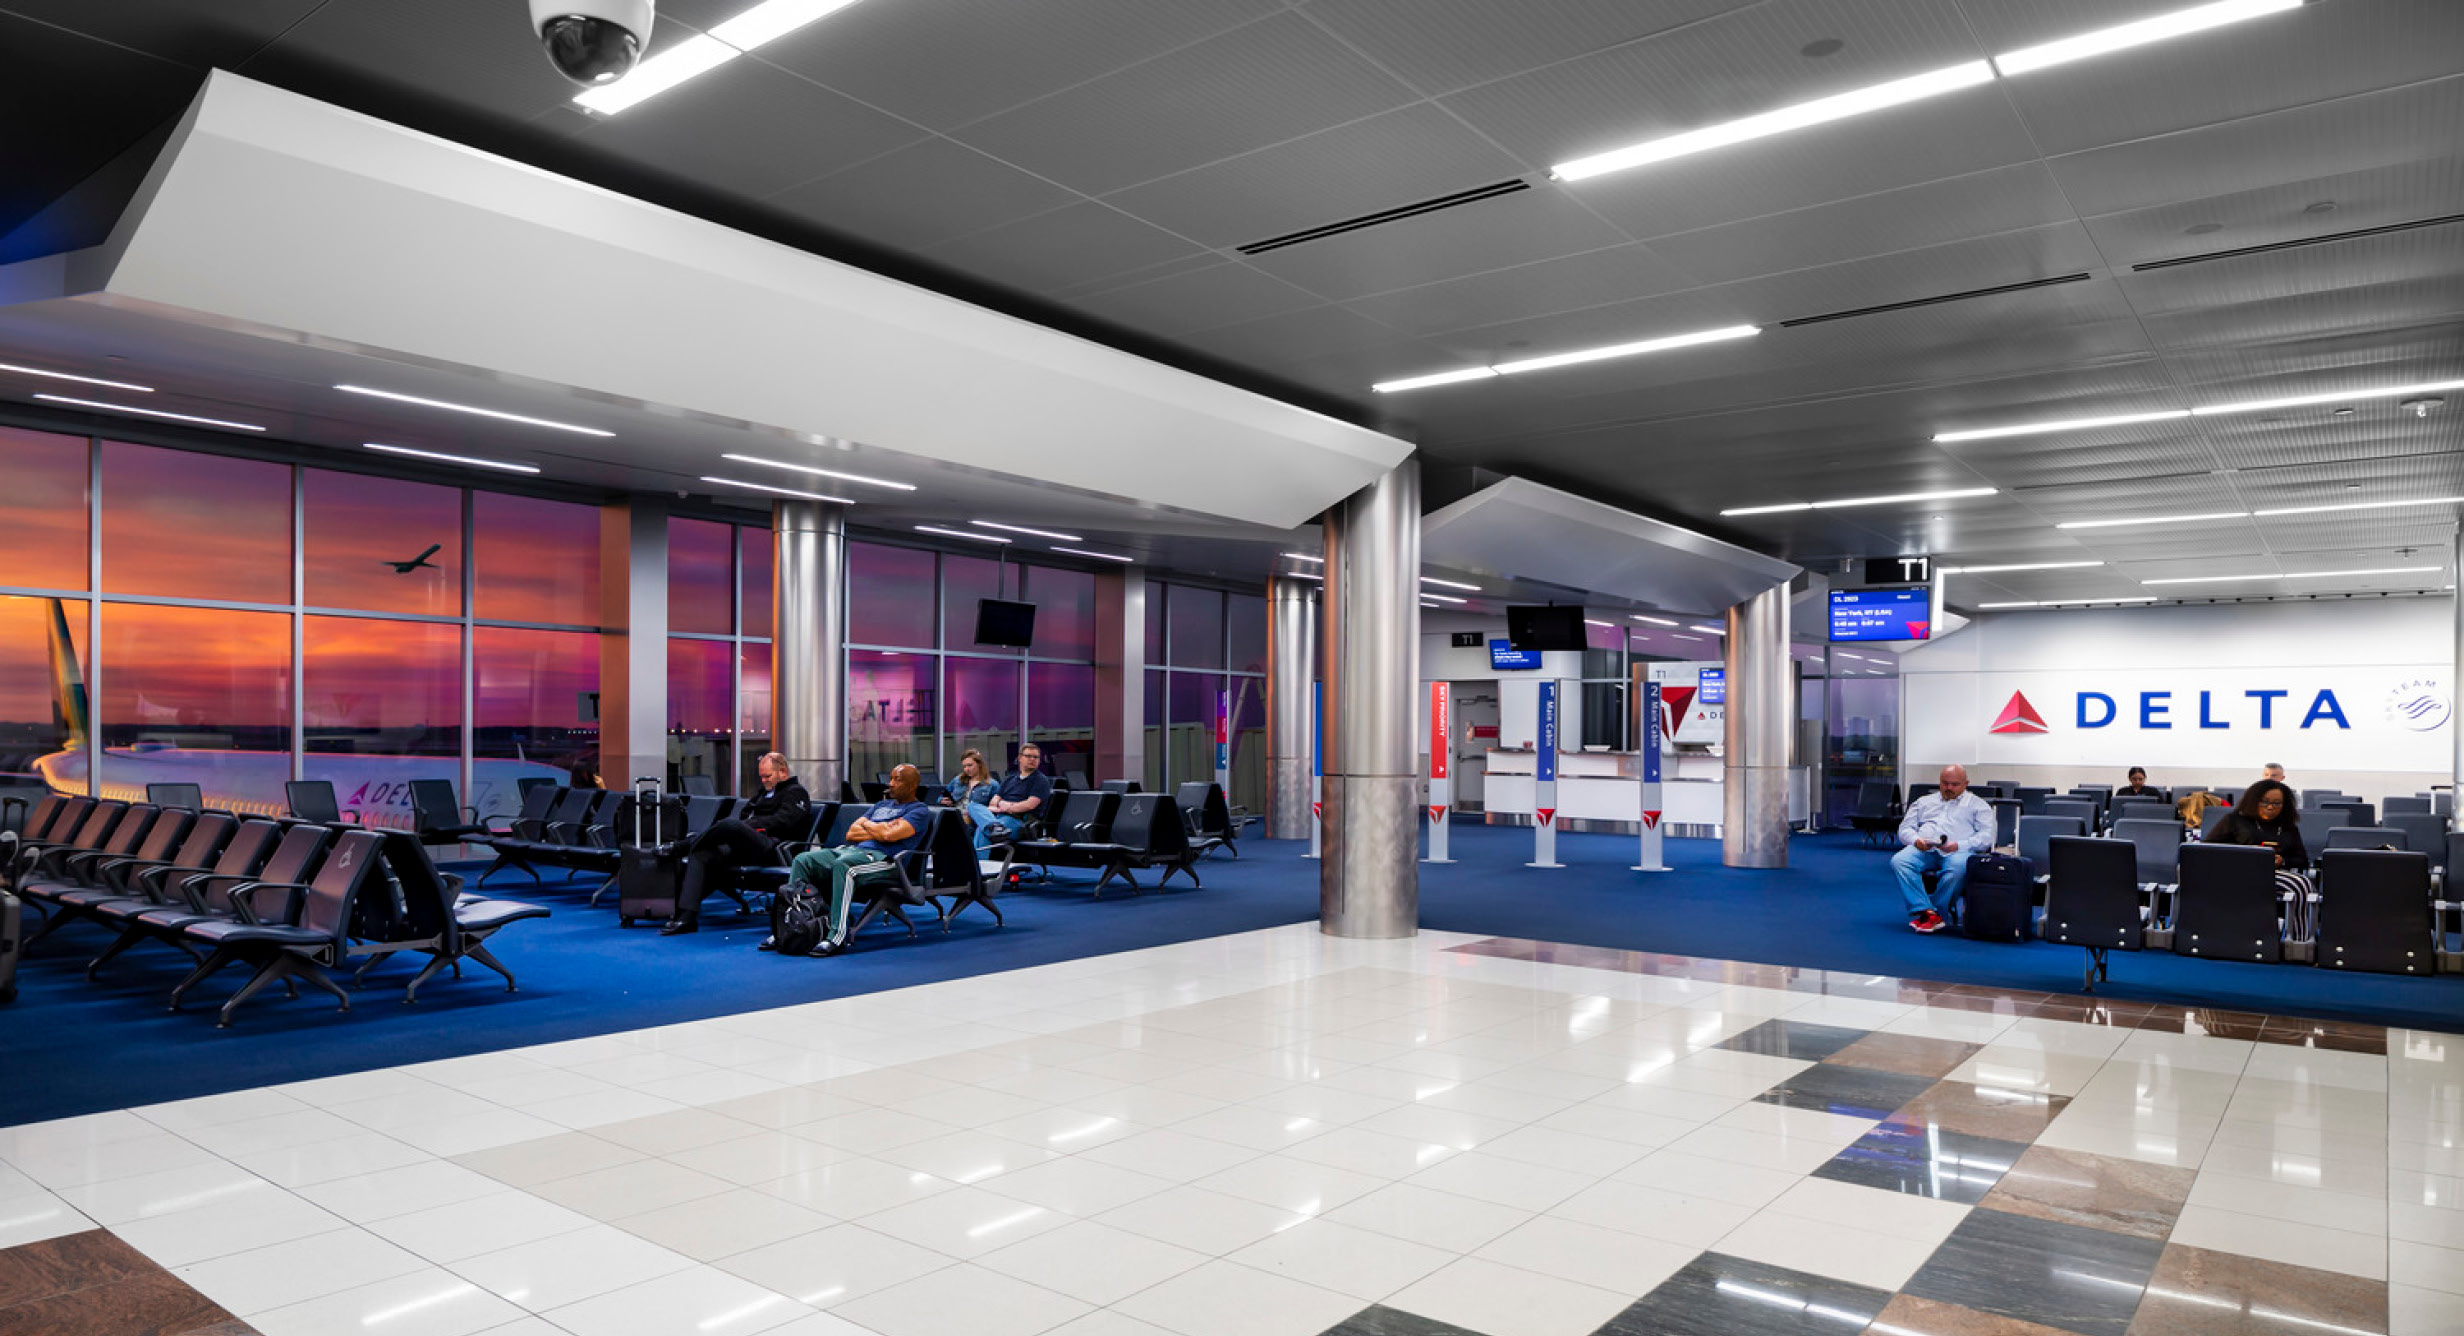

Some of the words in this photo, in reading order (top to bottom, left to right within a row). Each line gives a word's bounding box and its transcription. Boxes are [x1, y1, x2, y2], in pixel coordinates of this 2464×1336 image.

[1898, 558, 1928, 581] T1
[1549, 685, 1555, 697] 1
[1650, 685, 1659, 697] 2
[1546, 701, 1554, 721] Main
[1651, 701, 1659, 722] Main
[2075, 688, 2352, 730] DELTA
